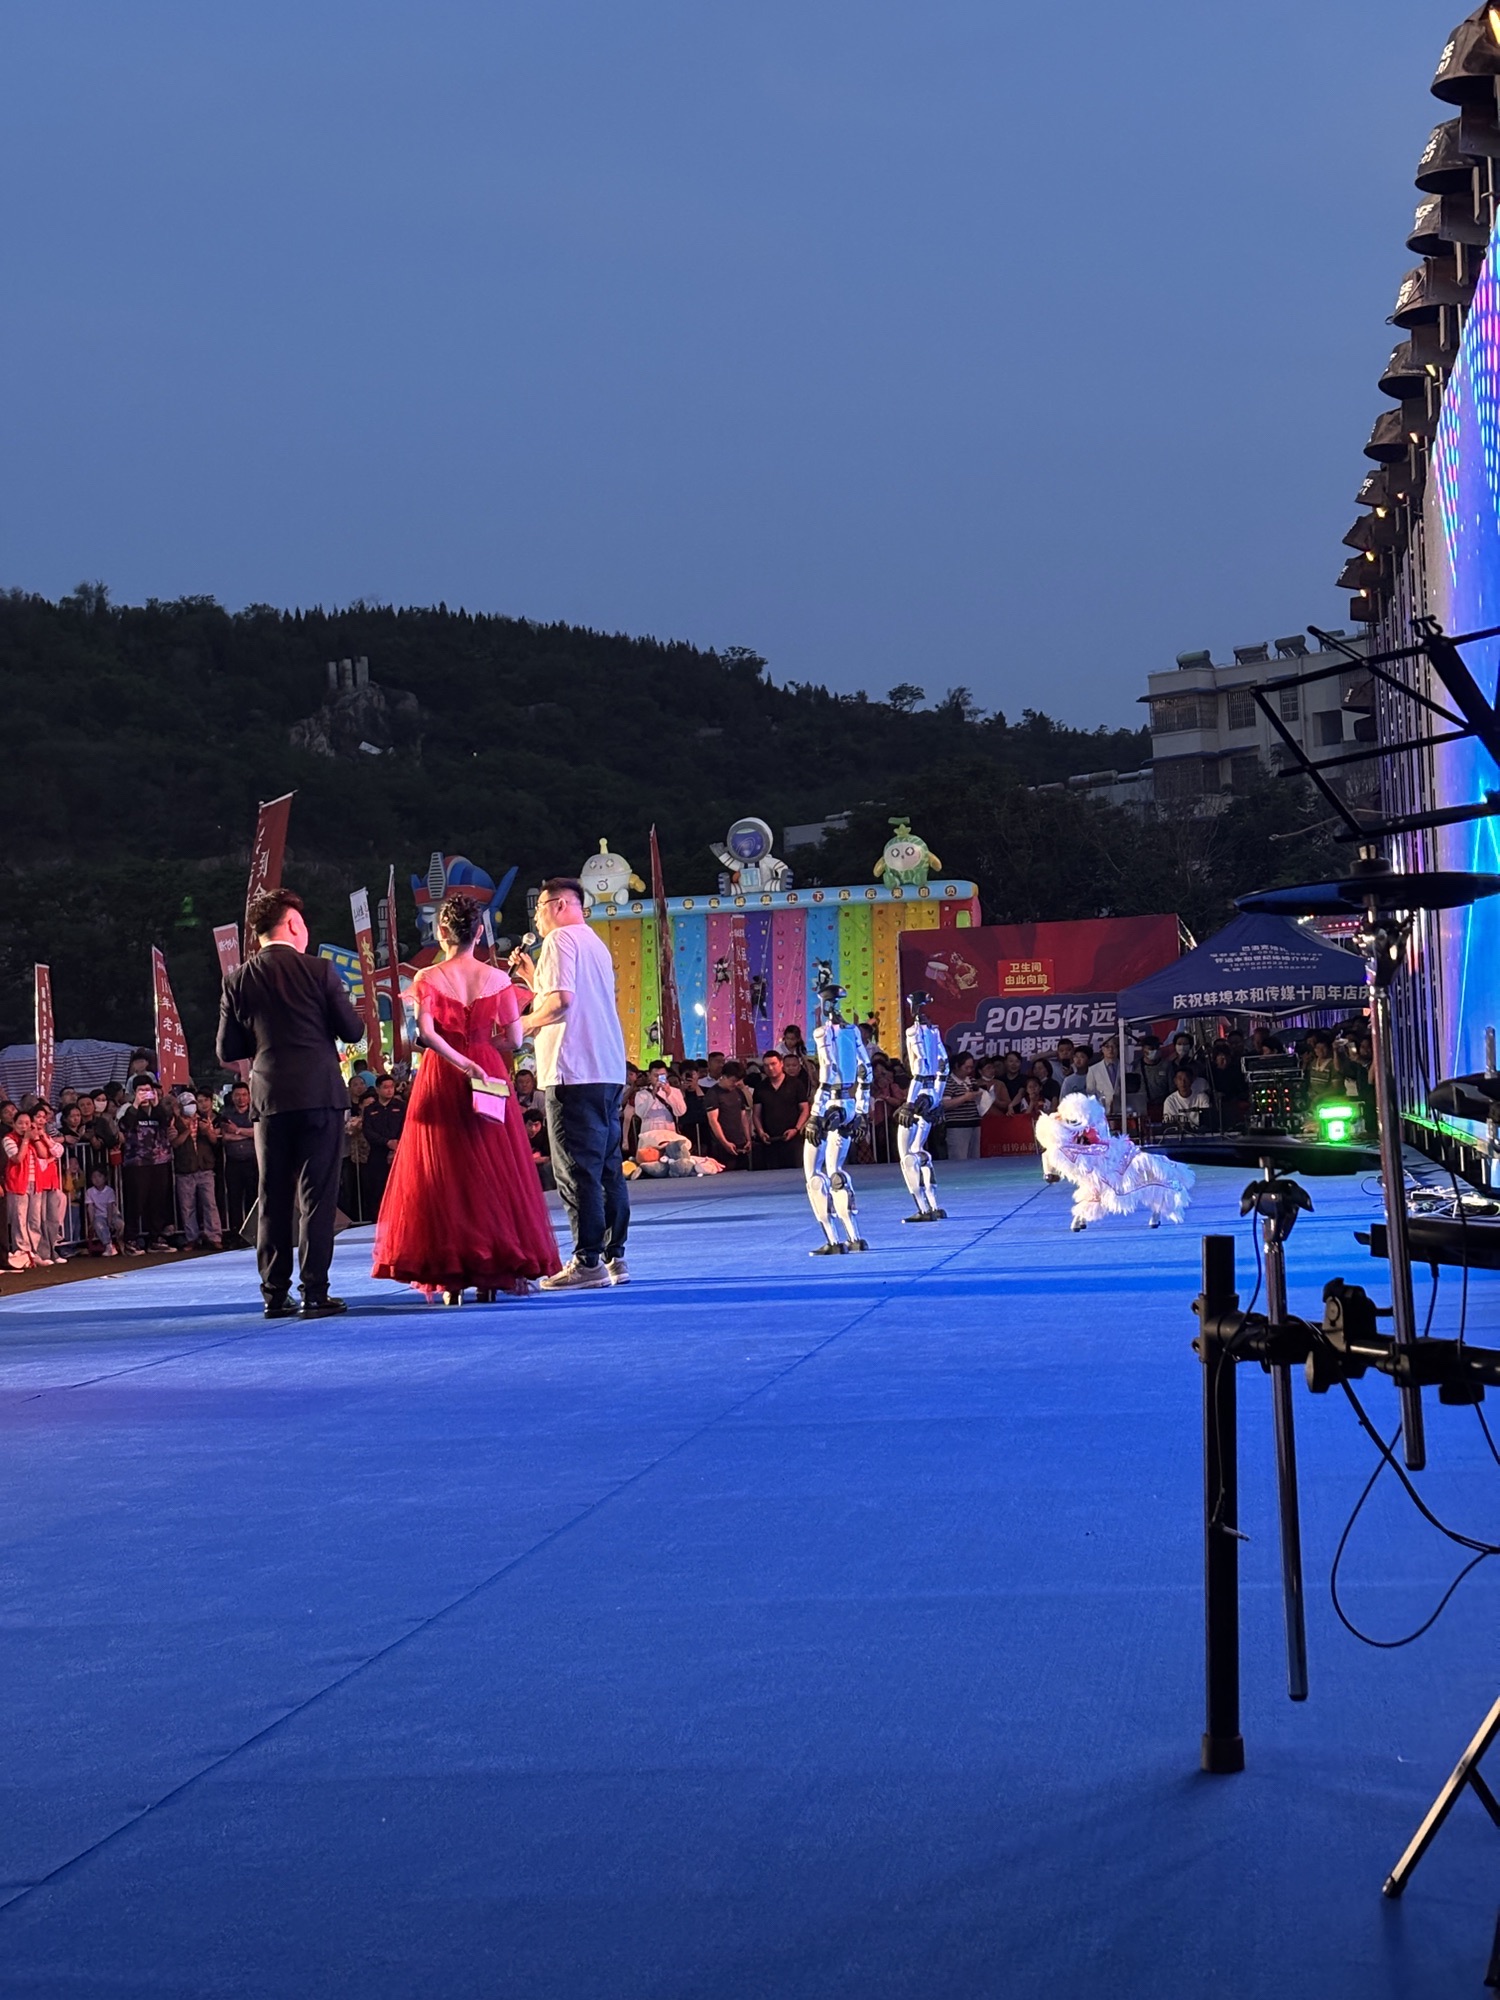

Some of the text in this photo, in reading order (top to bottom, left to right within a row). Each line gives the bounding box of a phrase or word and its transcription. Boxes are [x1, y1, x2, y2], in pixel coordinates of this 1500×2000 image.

[1009, 962, 1042, 973] 卫生间
[1005, 974, 1048, 985] 由此向前
[1172, 985, 1369, 1009] 庆祝蚌埠本和传媒十周年店庆
[985, 1002, 1116, 1033] 2025怀远
